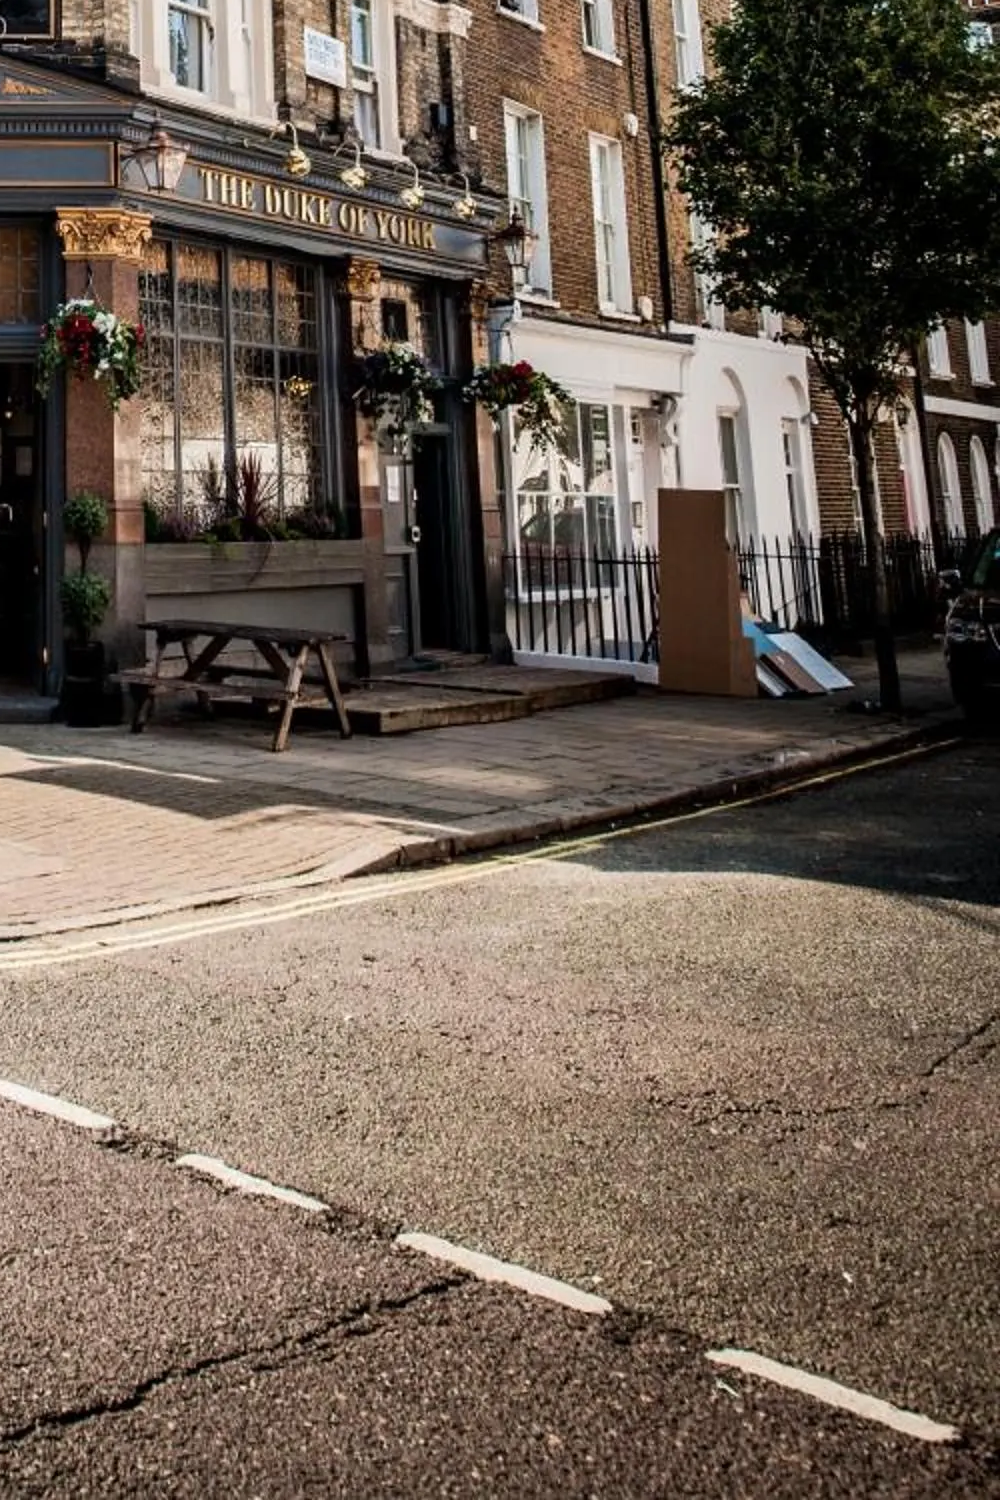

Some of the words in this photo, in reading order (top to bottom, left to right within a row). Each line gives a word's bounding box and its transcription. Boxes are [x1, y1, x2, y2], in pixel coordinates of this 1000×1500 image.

[199, 168, 257, 211] THE
[263, 184, 334, 227] DUKE
[338, 202, 370, 235] OF
[374, 211, 437, 250] YORK
